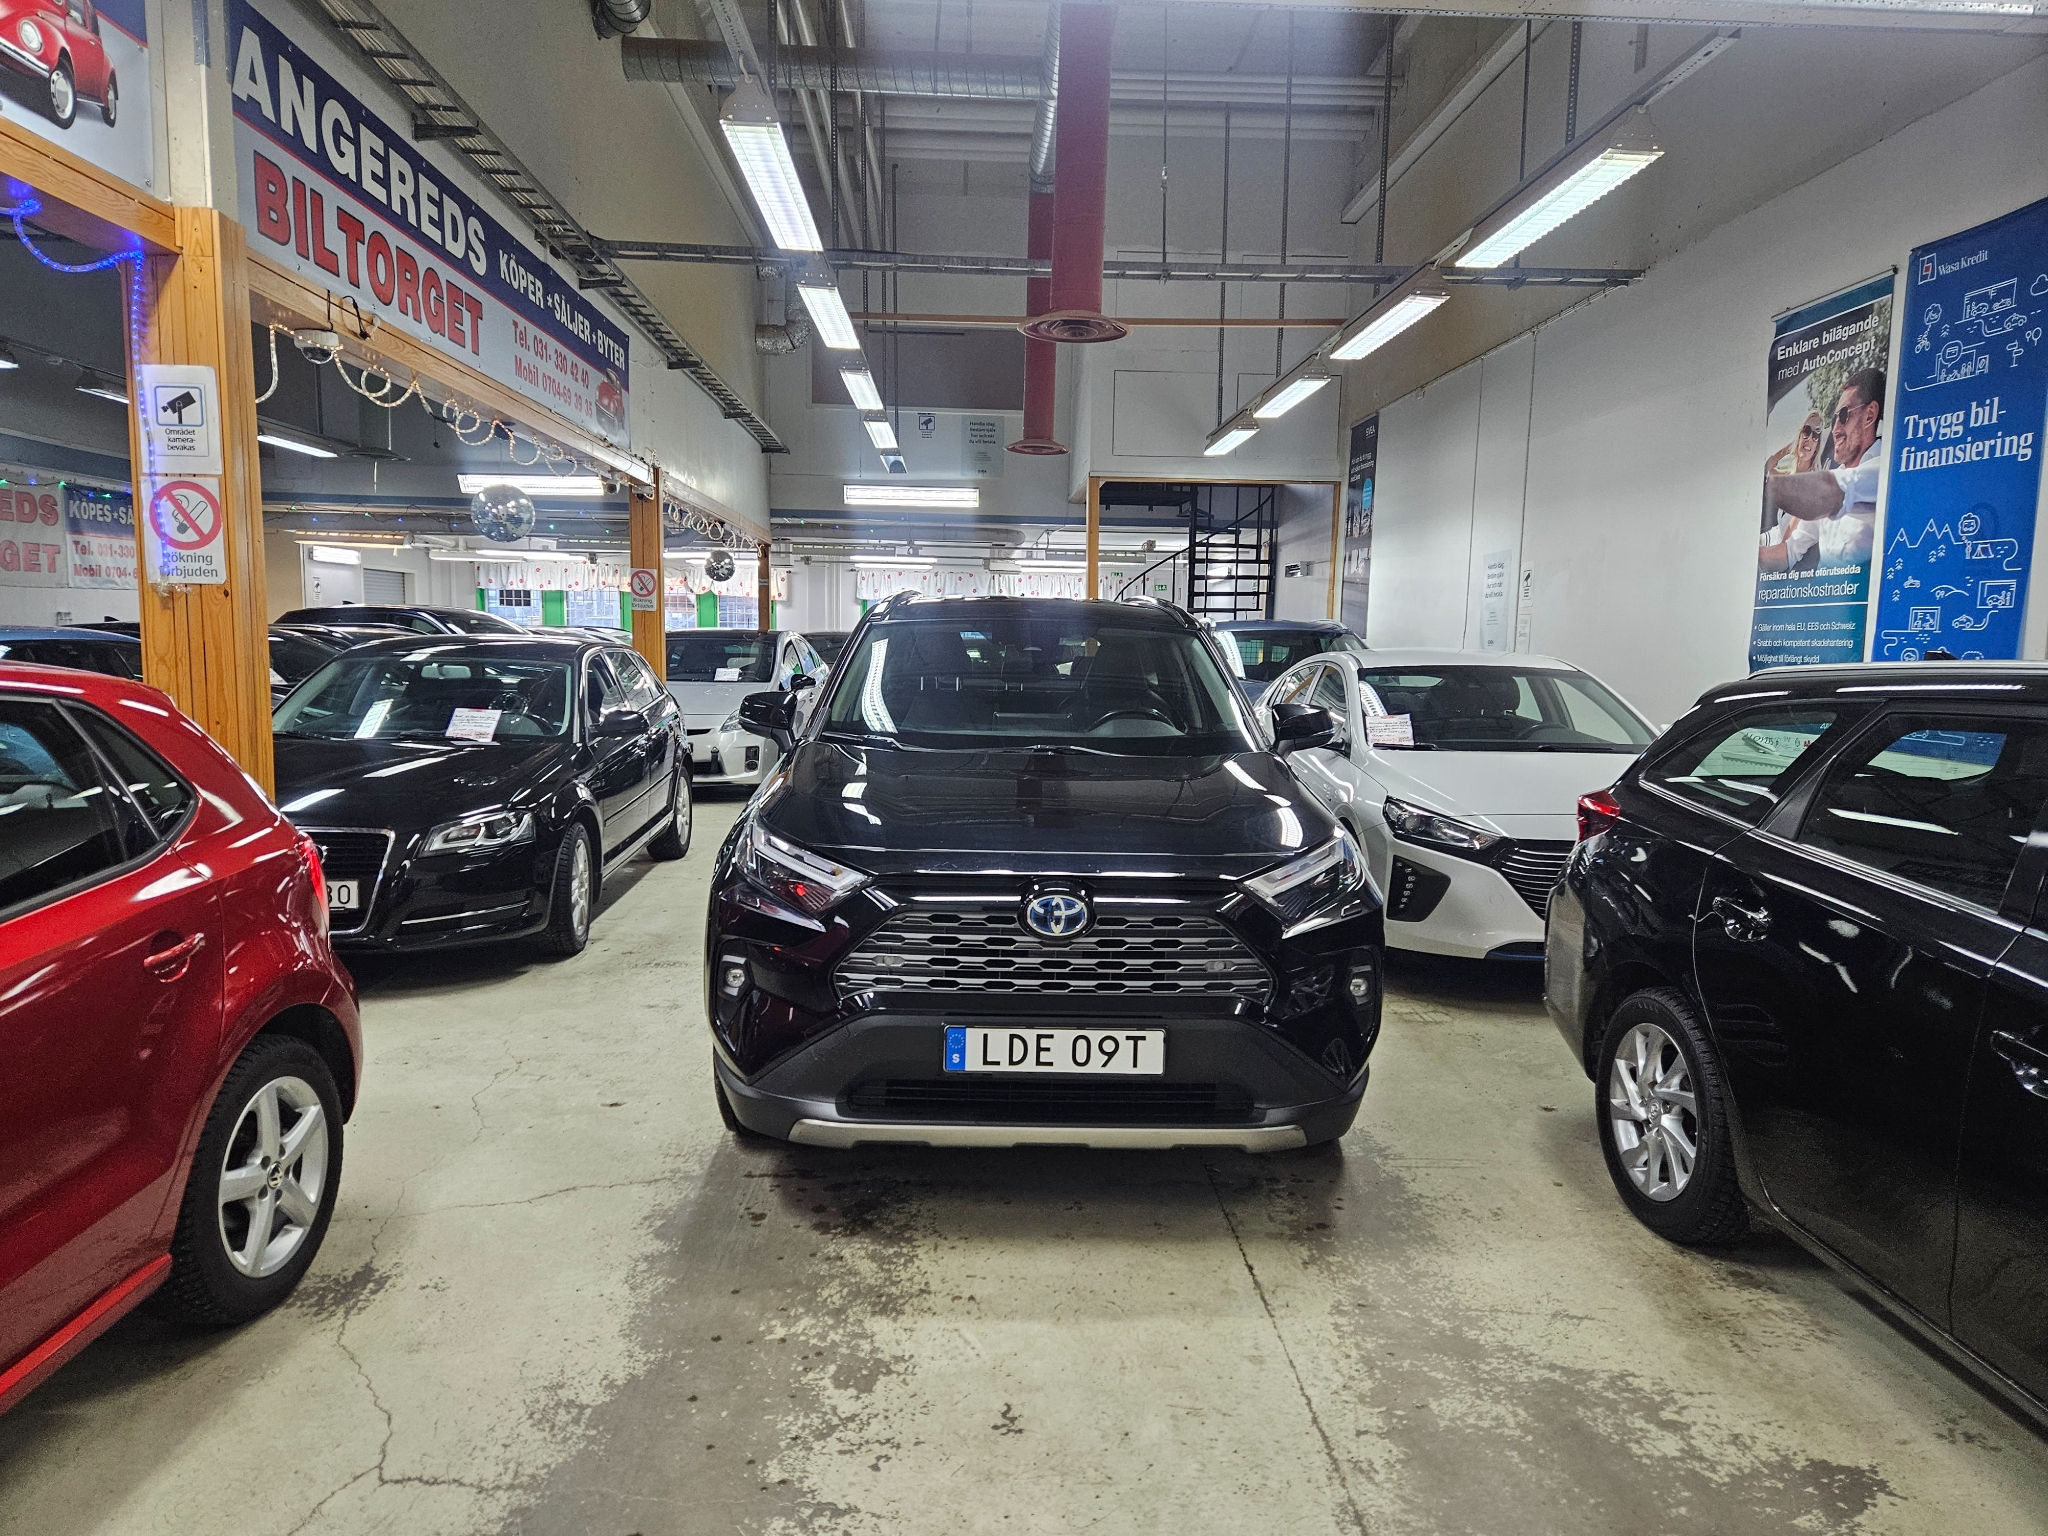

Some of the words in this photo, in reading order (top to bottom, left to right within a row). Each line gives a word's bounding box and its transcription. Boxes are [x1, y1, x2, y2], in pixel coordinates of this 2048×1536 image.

[231, 25, 487, 276] ANGEREDS
[253, 150, 483, 356] BILTORGET
[1938, 259, 1960, 276] Wasa
[1960, 250, 1988, 271] Kredit
[499, 249, 545, 310] KÖPER
[553, 292, 591, 346] SÄLJER
[597, 329, 625, 371] BYTER
[1777, 338, 1820, 361] Enklare
[1822, 314, 1879, 345] bilägande
[512, 319, 530, 352] Tel.
[554, 348, 568, 376] 330
[570, 361, 579, 383] 42
[581, 367, 589, 390] 40
[1777, 361, 1799, 380] med
[1801, 337, 1876, 373] AutoConcept
[514, 355, 539, 388] Mobil
[542, 372, 572, 407] 0704-69
[574, 392, 583, 414] 39
[585, 398, 593, 418] 35
[165, 428, 196, 436] Området
[1903, 408, 1966, 443] Trygg
[1969, 396, 2006, 428] bil-
[167, 443, 195, 451] bevakas
[1899, 432, 2034, 472] finansiering
[68, 498, 112, 522] KÖPES
[72, 540, 94, 555] Tel.
[97, 544, 135, 559] 031-330
[73, 563, 101, 577] Mobil
[1759, 571, 1787, 581] Försäkra
[1788, 569, 1799, 580] dig
[1801, 568, 1814, 578] mot
[1815, 565, 1861, 577] oförutsedda
[1758, 580, 1860, 603] reparationskostnader
[1807, 622, 1819, 630] EES
[1820, 622, 1830, 630] och
[1831, 621, 1856, 630] Schweiz
[1757, 639, 1772, 647] Snabb
[1773, 639, 1783, 647] och
[1783, 639, 1810, 648] kompetent
[1811, 638, 1854, 648] skadehantering
[1803, 654, 1820, 664] skydd
[952, 1053, 960, 1063] S
[982, 1033, 1055, 1066] LDE
[1071, 1034, 1147, 1069] 09T
